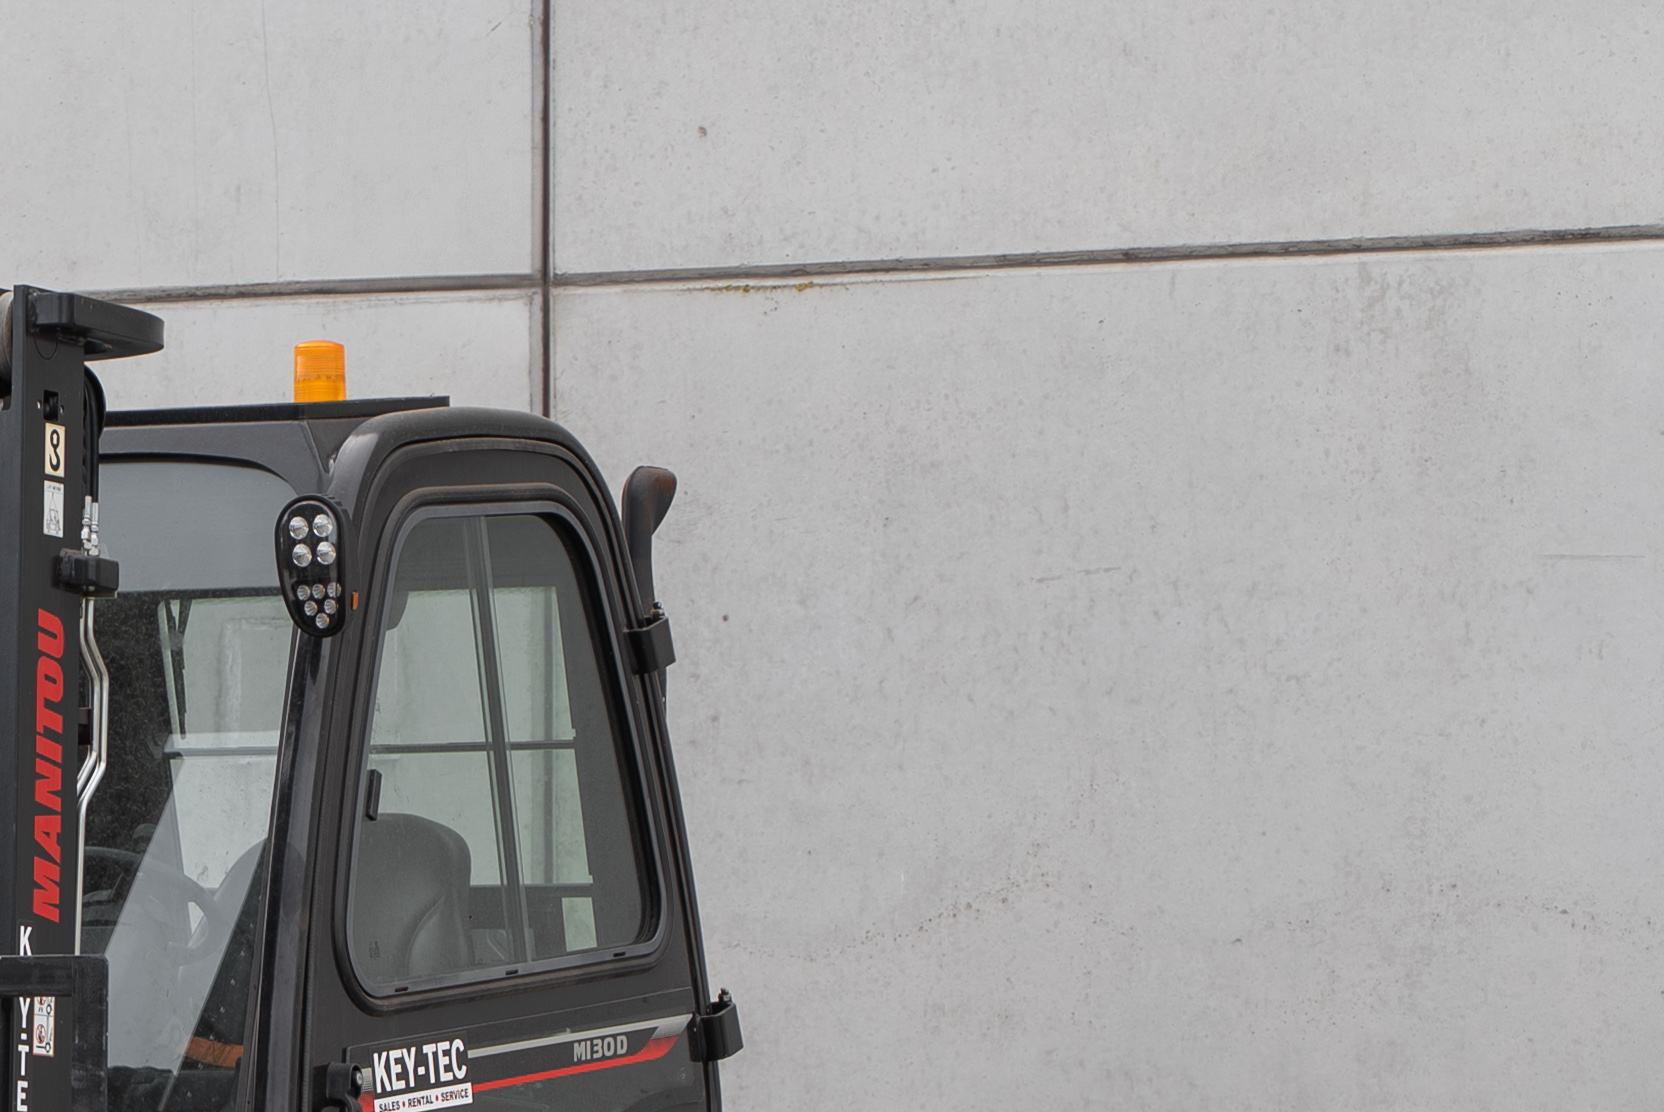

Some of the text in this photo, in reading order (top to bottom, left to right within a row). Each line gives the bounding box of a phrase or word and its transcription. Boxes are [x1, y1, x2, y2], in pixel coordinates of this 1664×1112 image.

[32, 608, 65, 923] MANITOU
[373, 1038, 467, 1094] KEY-TEC
[407, 1094, 434, 1109] RENTAL
[440, 1087, 469, 1102] SERVICE
